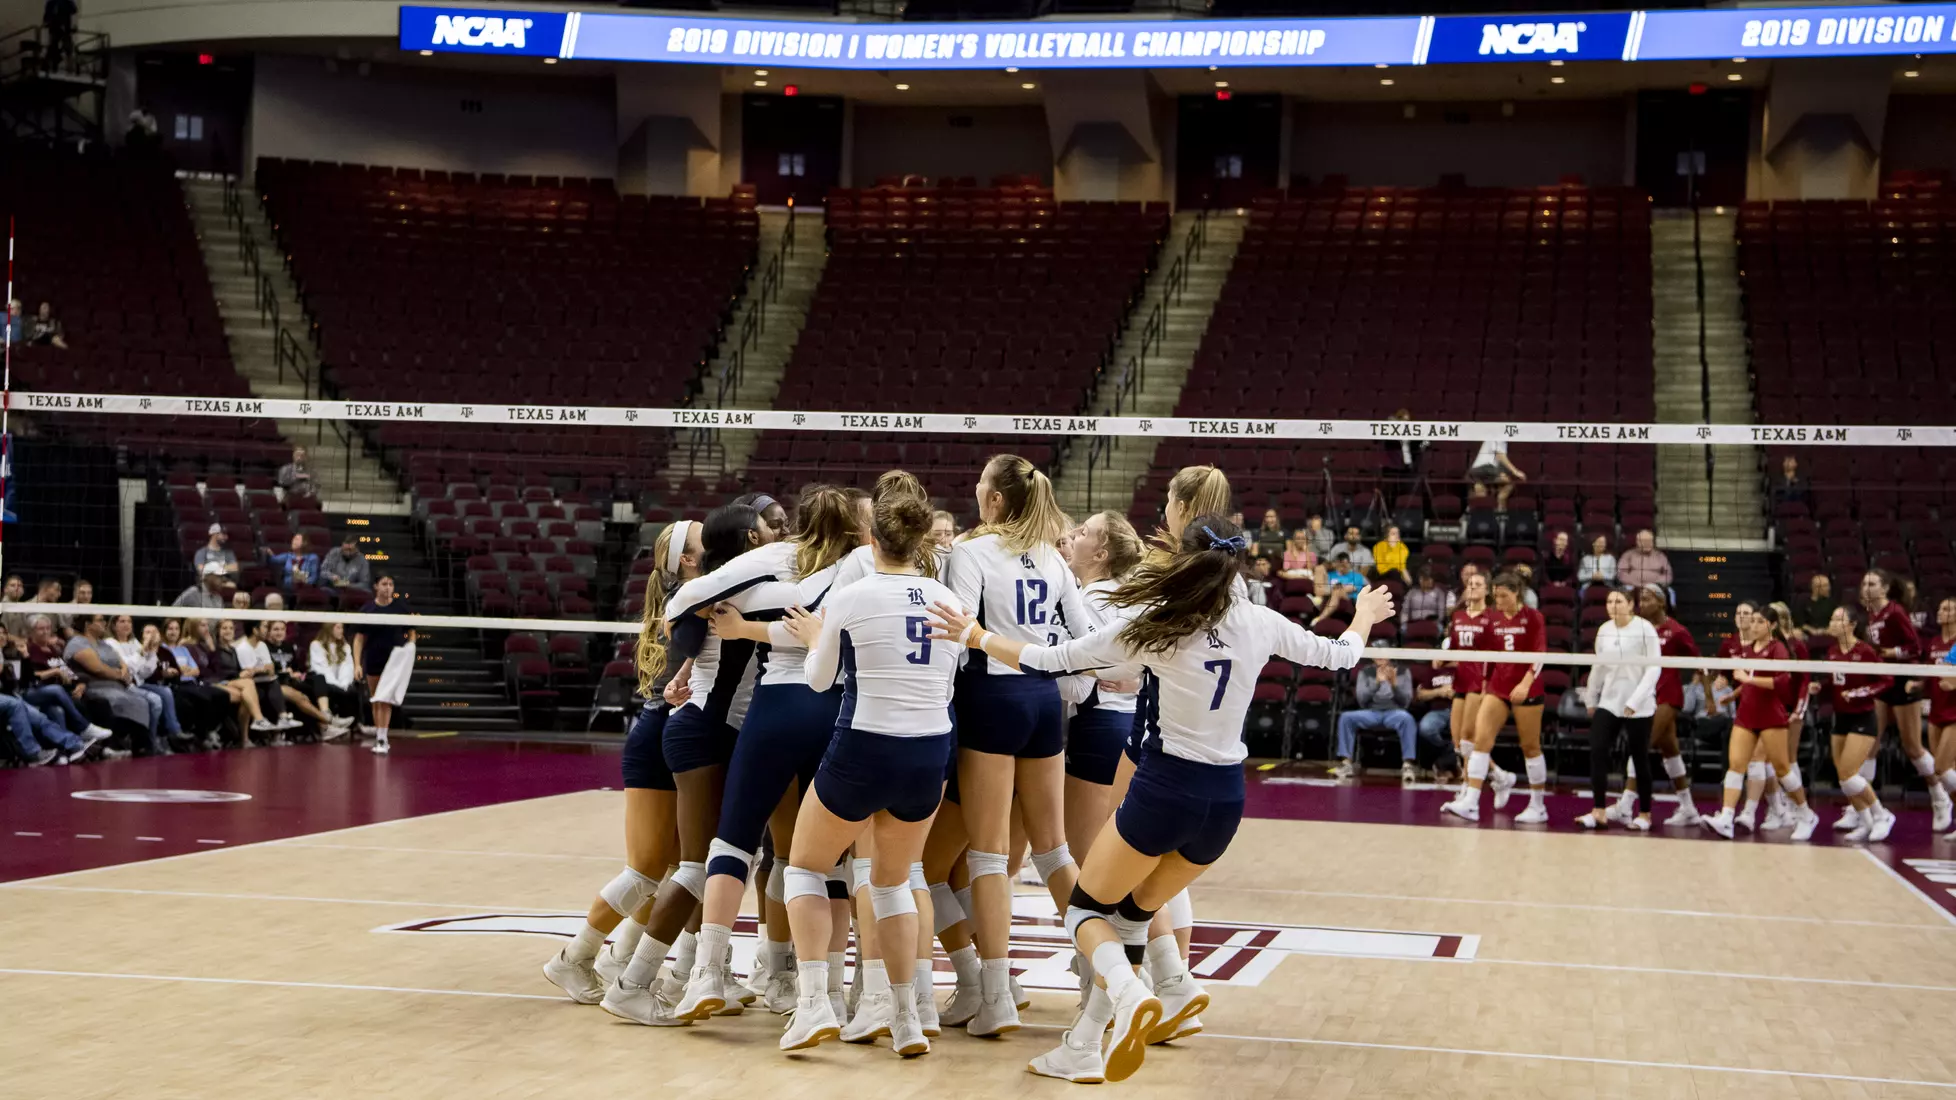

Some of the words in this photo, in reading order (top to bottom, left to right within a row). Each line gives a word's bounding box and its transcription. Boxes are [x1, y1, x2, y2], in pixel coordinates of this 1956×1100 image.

[432, 15, 528, 48] NCAA
[1741, 18, 1811, 47] 2019
[1816, 15, 1944, 45] DIVISION
[667, 27, 729, 54] 2019
[732, 29, 844, 59] DIVISION
[847, 34, 860, 59] I
[865, 33, 979, 59] WOMEN'S
[984, 31, 1126, 59] VOLLEYBALL
[1132, 29, 1326, 58] CHAMPIONSHIP
[1479, 22, 1582, 55] NCAA
[28, 394, 72, 408] TEXAS
[76, 395, 103, 409] A&M
[185, 400, 230, 412] TEXAS
[235, 402, 263, 413] A&M
[345, 404, 391, 417] TEXAS
[396, 405, 424, 418] A&M
[507, 408, 554, 420] TEXAS
[559, 409, 587, 421] A&M
[672, 411, 719, 424] TEXAS
[724, 412, 753, 425] A&M
[840, 415, 888, 428] TEXAS
[894, 416, 923, 429] A&M
[1012, 418, 1061, 431] TEXAS
[1067, 419, 1097, 431] A&M
[1188, 421, 1239, 434] TEXAS
[1245, 422, 1275, 435] A&M
[1370, 423, 1421, 436] TEXAS
[1428, 425, 1460, 437] A&M
[1556, 426, 1610, 439] TEXAS
[1616, 427, 1650, 440] A&M
[1751, 428, 1807, 441] TEXAS
[1813, 429, 1848, 441] A&M
[1015, 579, 1048, 625] 12
[905, 616, 932, 665] 9
[1458, 631, 1474, 647] 10
[1503, 633, 1515, 651] 2
[1204, 659, 1232, 711] 7
